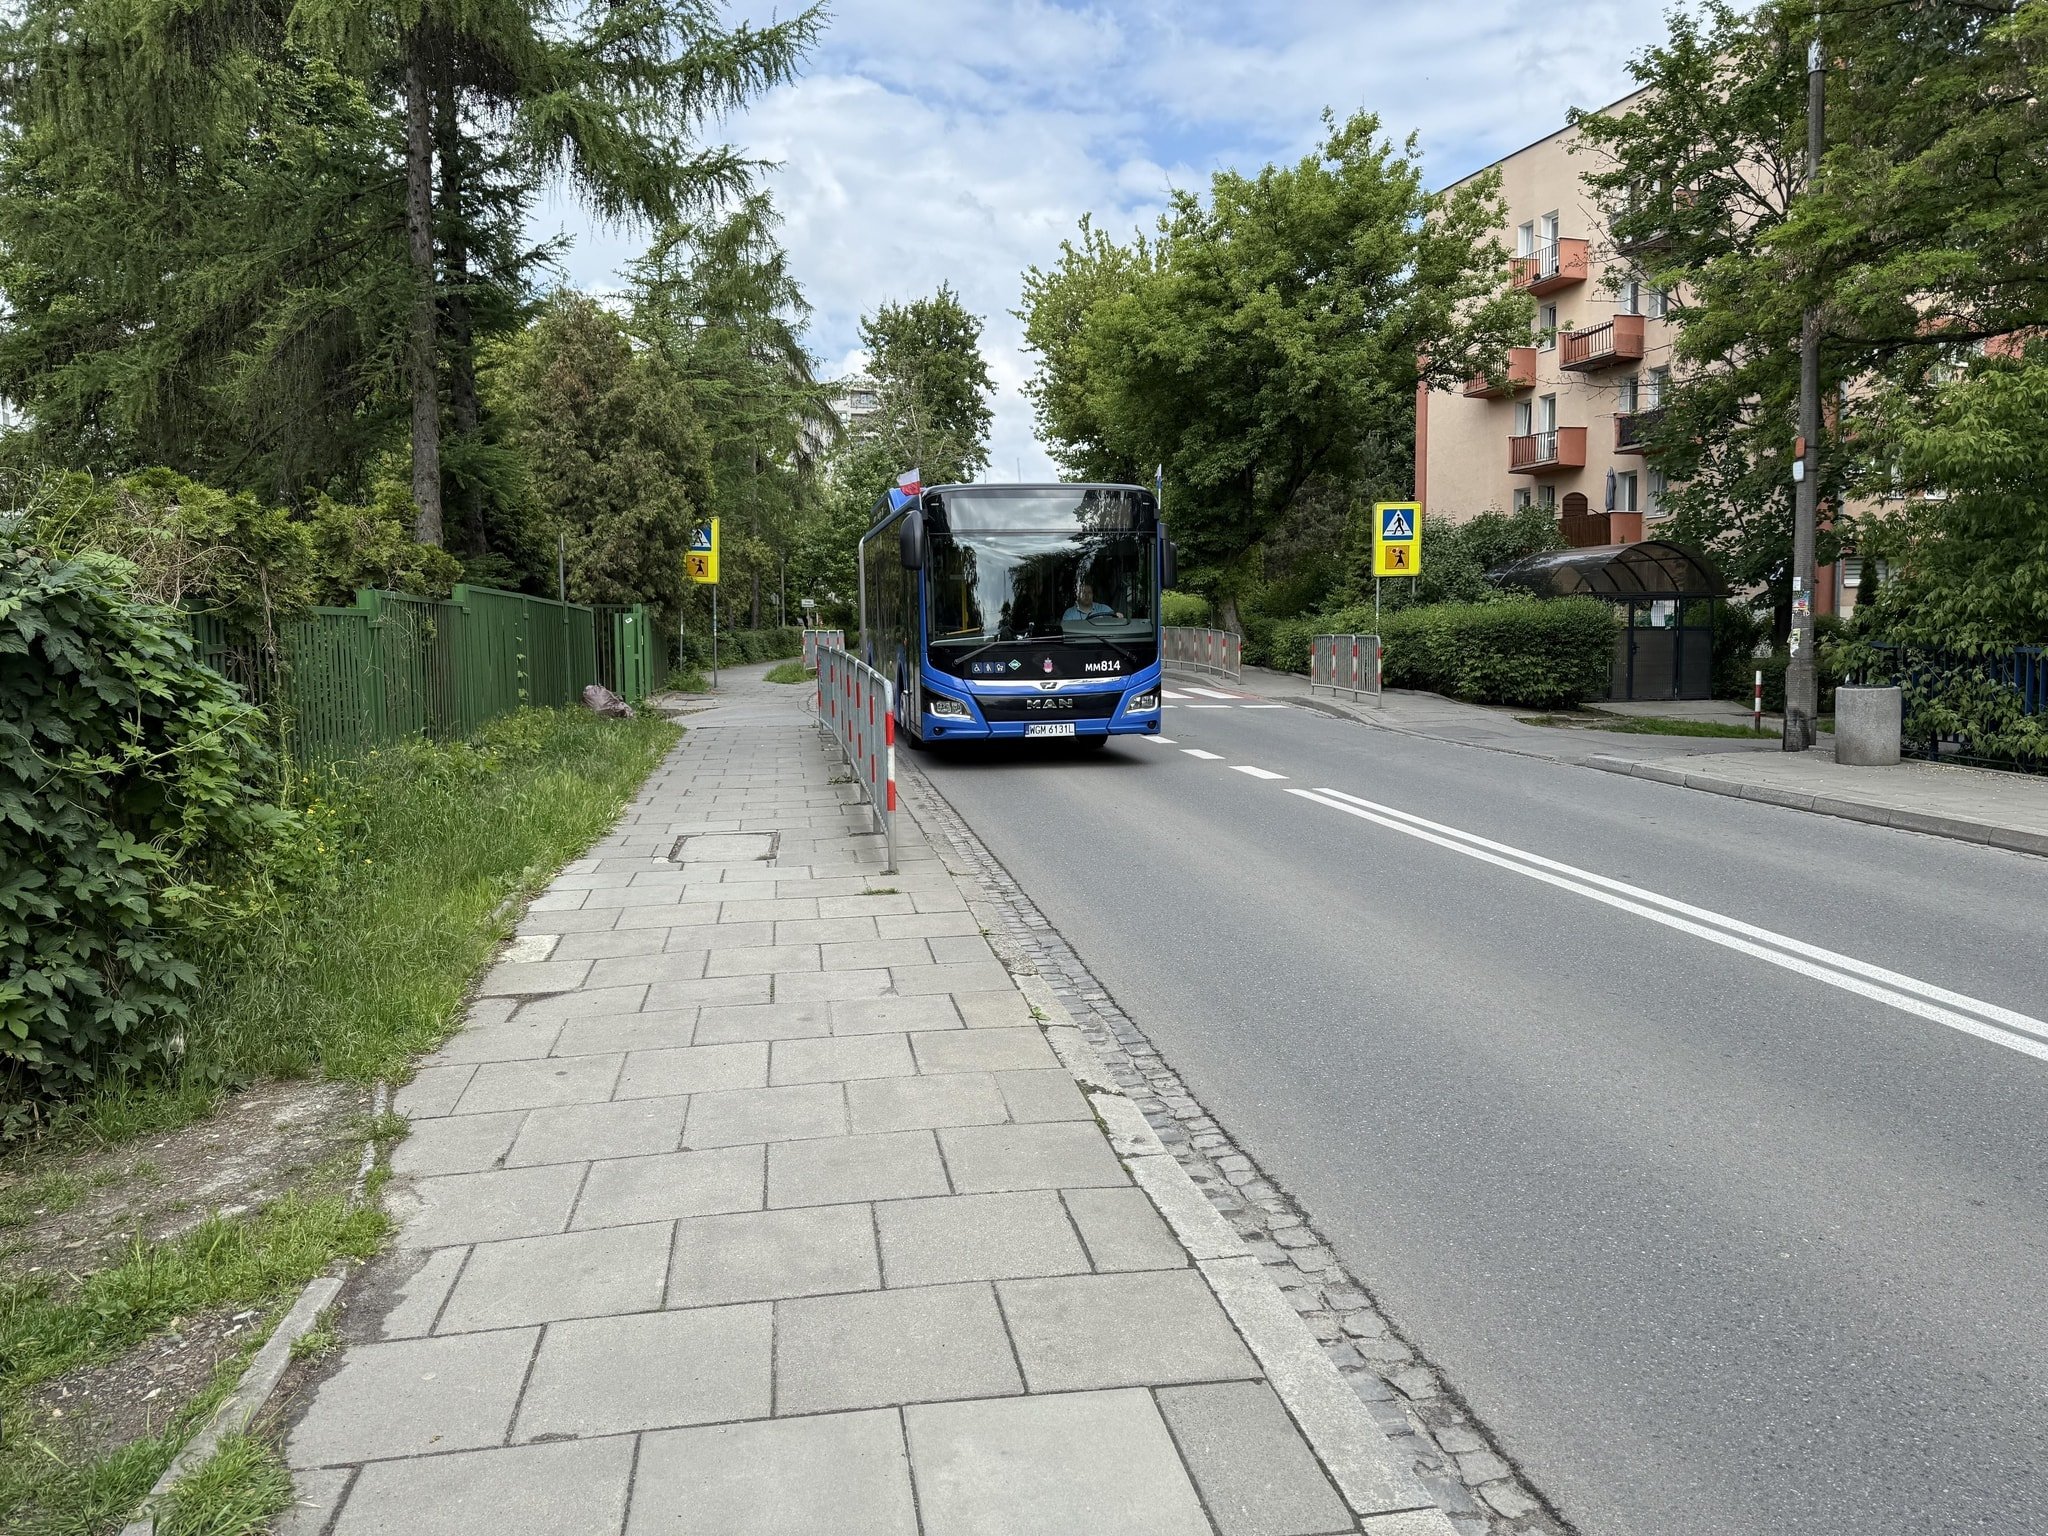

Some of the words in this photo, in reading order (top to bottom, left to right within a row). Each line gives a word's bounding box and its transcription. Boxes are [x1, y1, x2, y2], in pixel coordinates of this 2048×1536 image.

[1085, 660, 1121, 672] MM814
[1027, 698, 1073, 709] MAN
[1030, 724, 1046, 735] WGM
[1048, 724, 1074, 734] 6131L
